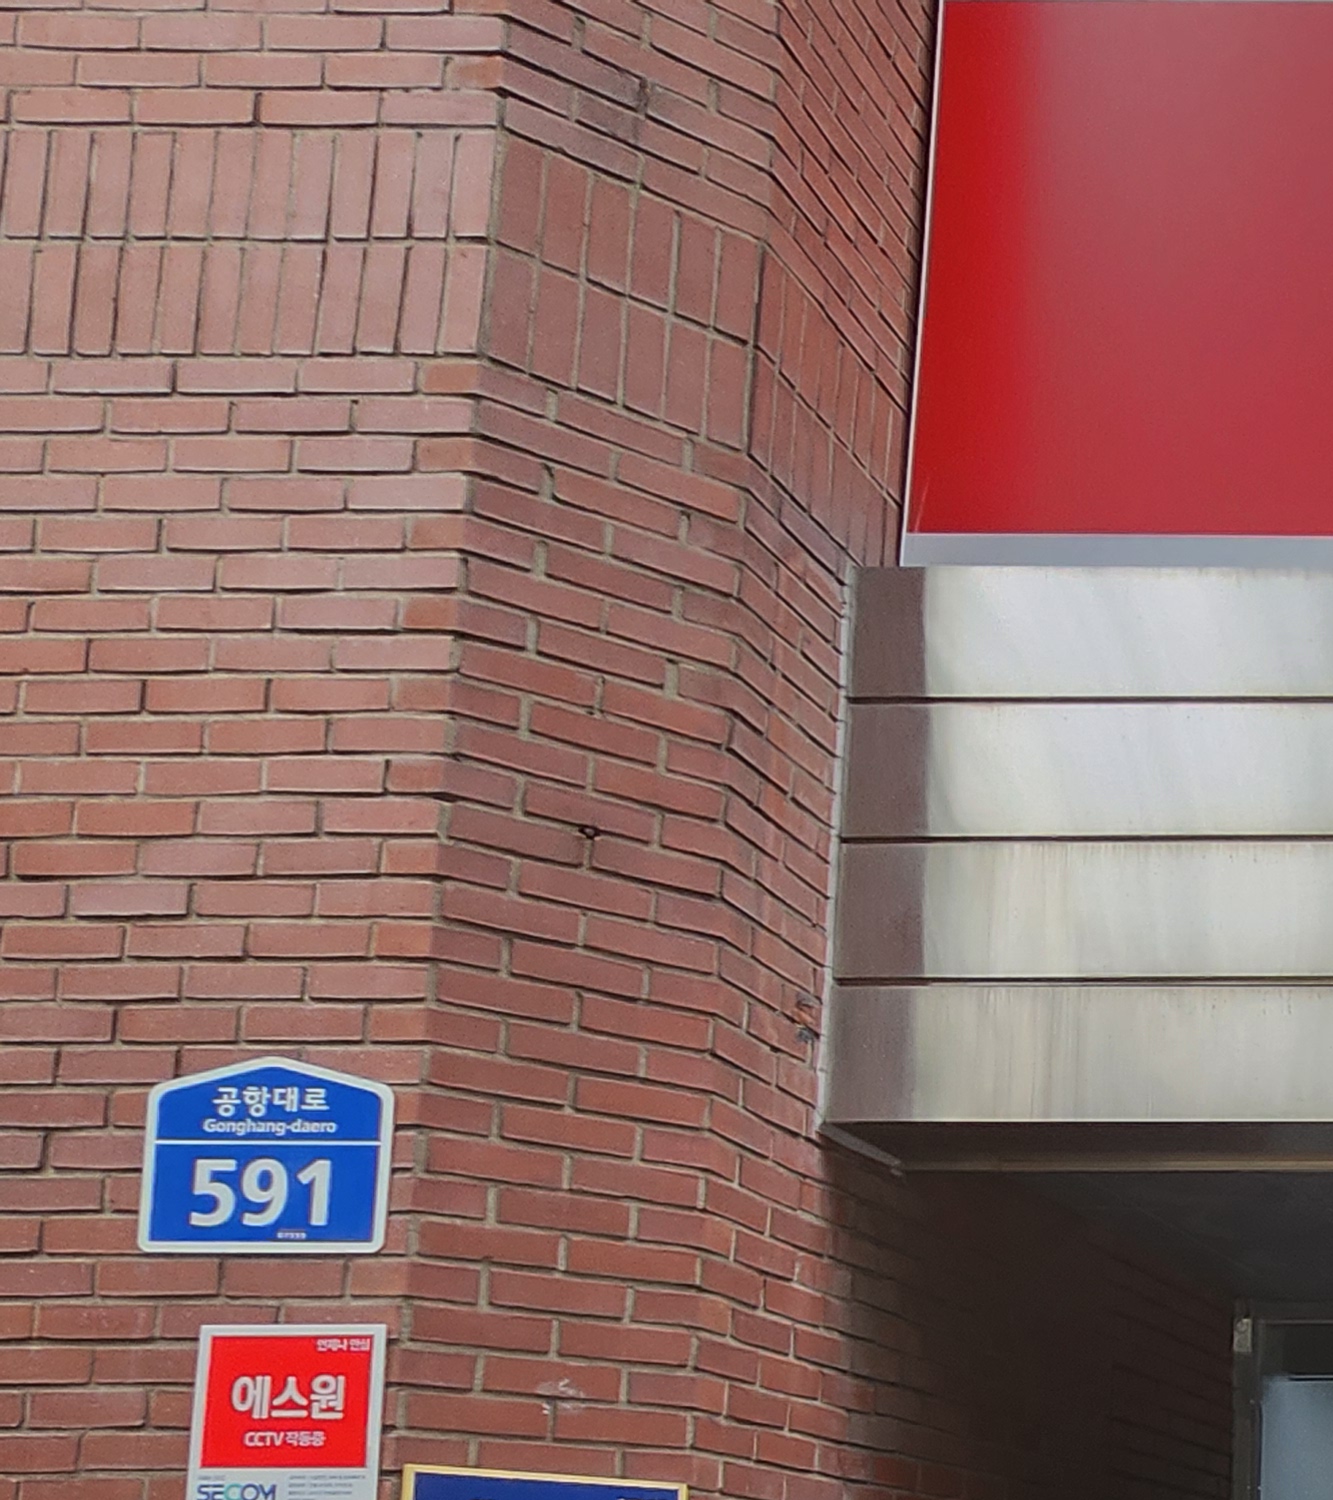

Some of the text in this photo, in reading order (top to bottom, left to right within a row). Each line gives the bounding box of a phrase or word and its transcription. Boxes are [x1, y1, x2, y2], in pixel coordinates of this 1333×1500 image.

[212, 1085, 330, 1117] 공항대로
[203, 1118, 338, 1136] Gonghang-daero
[189, 1158, 332, 1227] 591
[231, 1374, 346, 1420] 에스원
[244, 1431, 326, 1447] CCTV 작동중
